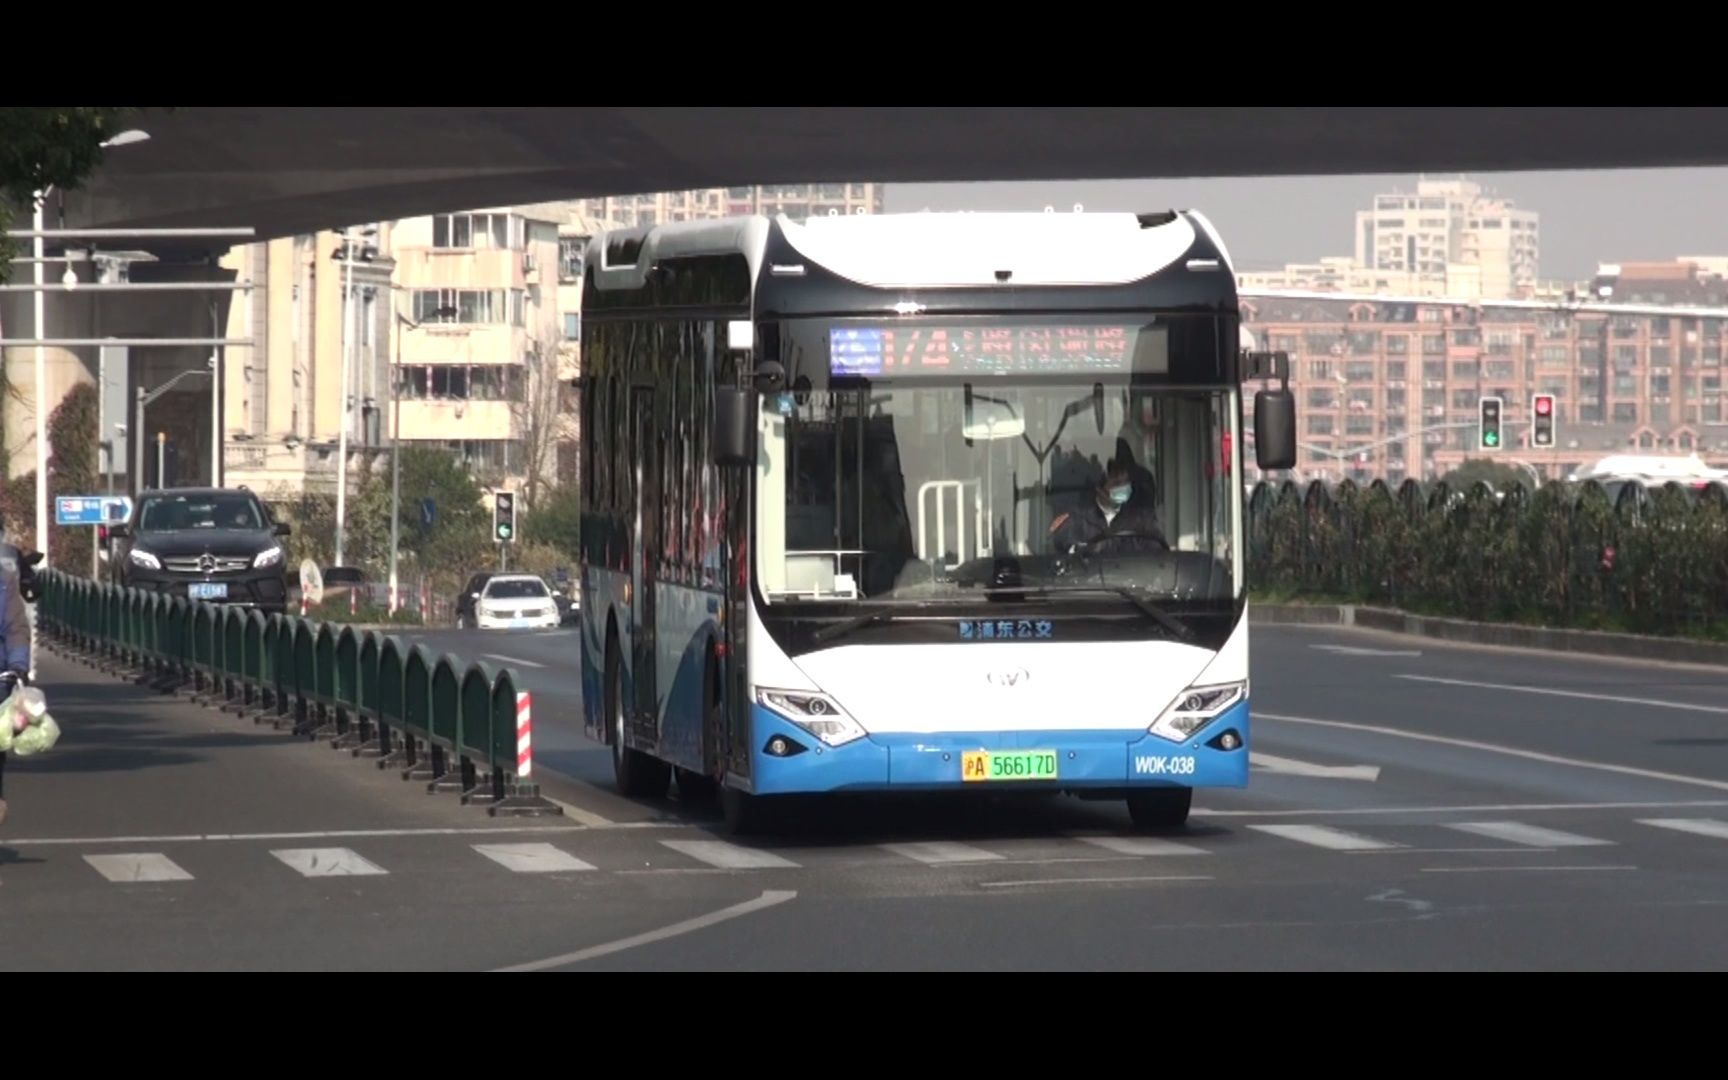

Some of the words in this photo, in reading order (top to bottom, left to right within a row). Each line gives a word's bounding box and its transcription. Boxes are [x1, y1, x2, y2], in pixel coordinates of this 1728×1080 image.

[976, 620, 1053, 638] 浦东公交
[993, 754, 1055, 776] 56617D
